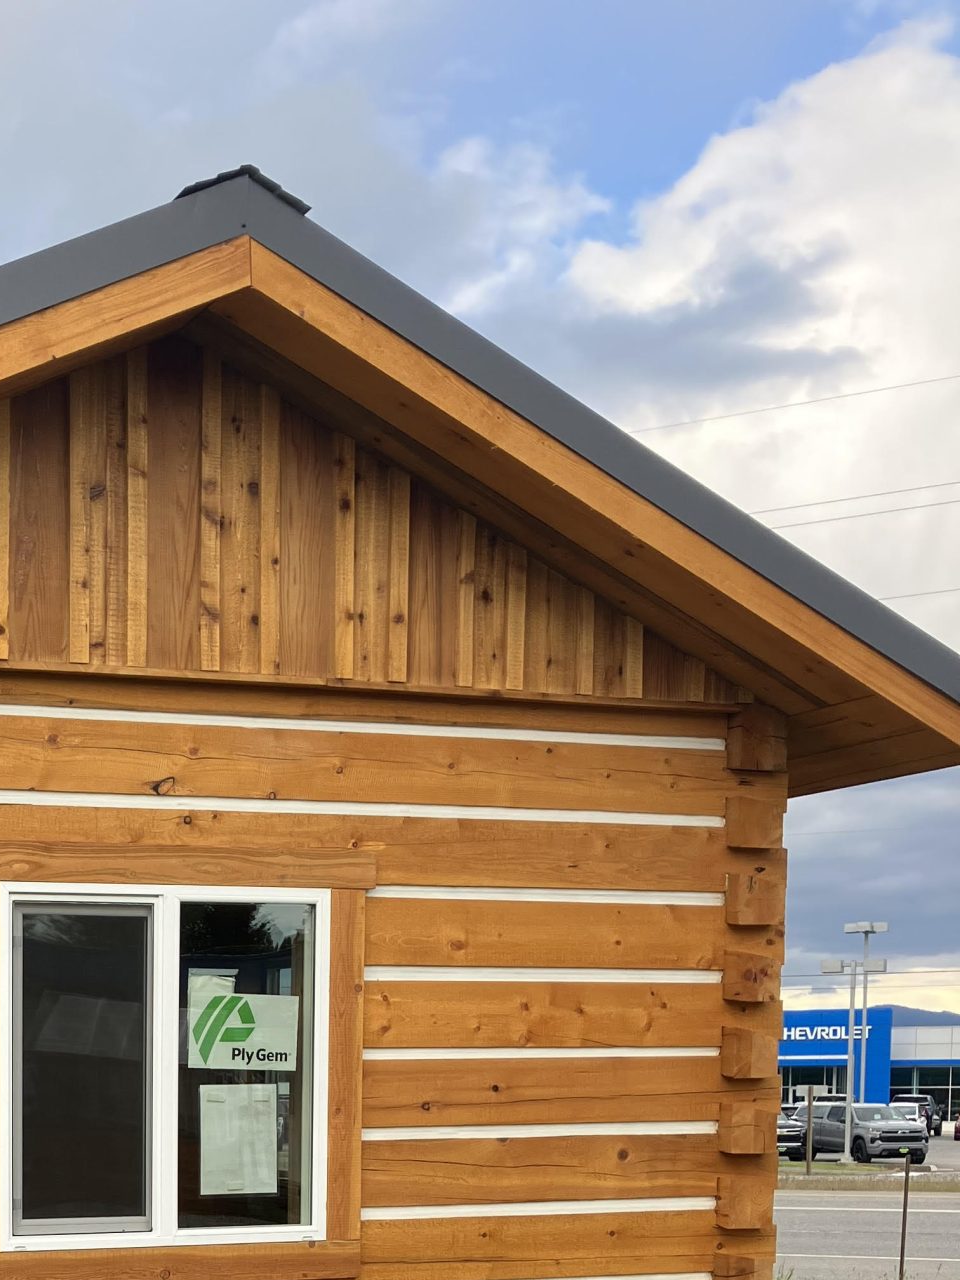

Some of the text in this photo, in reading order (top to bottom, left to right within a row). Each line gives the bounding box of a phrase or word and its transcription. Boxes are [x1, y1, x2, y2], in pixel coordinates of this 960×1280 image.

[783, 1025, 872, 1040] HEVROLET
[231, 1047, 288, 1066] Ply Gem
